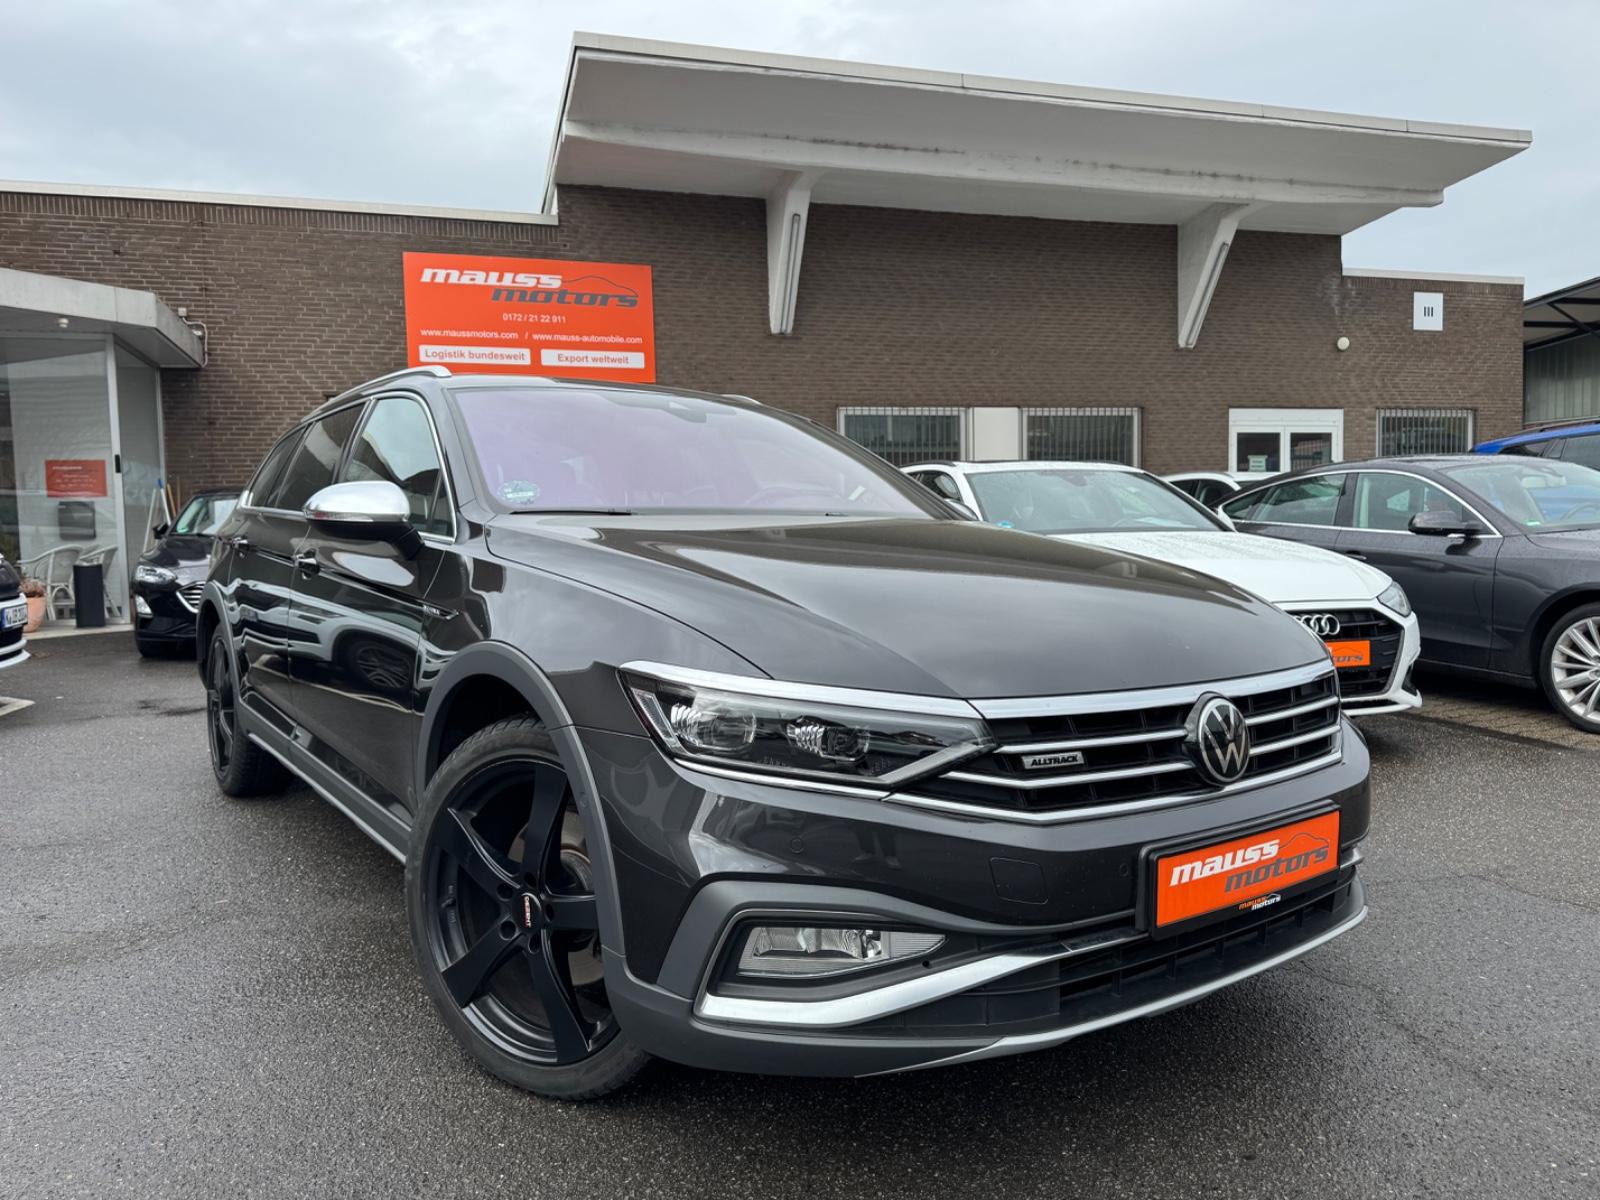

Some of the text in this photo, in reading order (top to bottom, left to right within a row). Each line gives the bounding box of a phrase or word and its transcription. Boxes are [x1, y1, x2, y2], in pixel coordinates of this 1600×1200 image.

[420, 268, 562, 289] mauss
[491, 288, 639, 308] motors
[502, 312, 522, 323] 0172
[528, 314, 539, 323] 21
[540, 314, 551, 323] 22
[552, 315, 567, 324] 911
[420, 329, 519, 340] www.maussmotors.com
[532, 333, 643, 345] www.mauss-automobile.com
[425, 349, 526, 362] Logistik bundesweit
[557, 353, 630, 365] Export weltweit
[1031, 754, 1078, 766] ALLTRACK
[1169, 839, 1281, 887] mauss
[1224, 845, 1330, 893] motors
